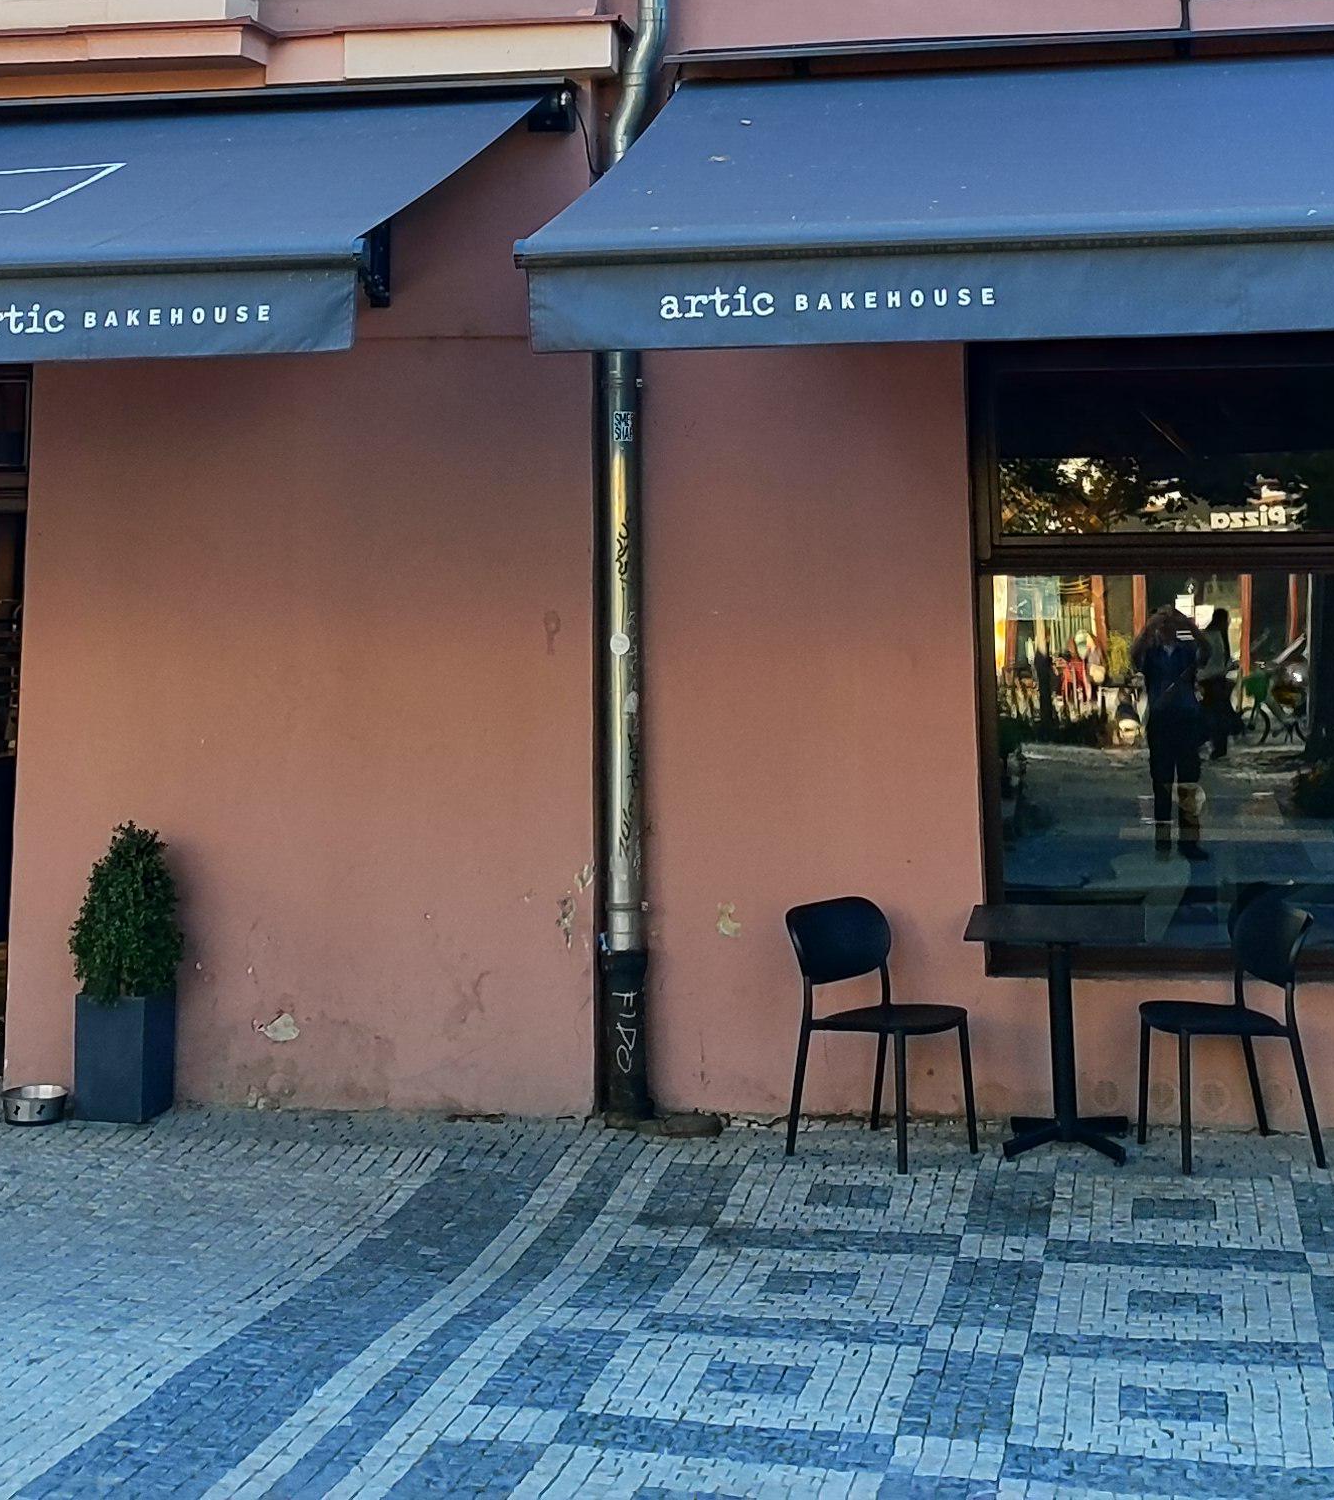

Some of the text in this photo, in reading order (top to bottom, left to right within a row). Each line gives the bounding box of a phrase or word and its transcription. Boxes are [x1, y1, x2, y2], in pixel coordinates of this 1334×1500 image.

[660, 285, 995, 319] artic BAKEHOUSE
[84, 305, 270, 328] BAKEHOUSE
